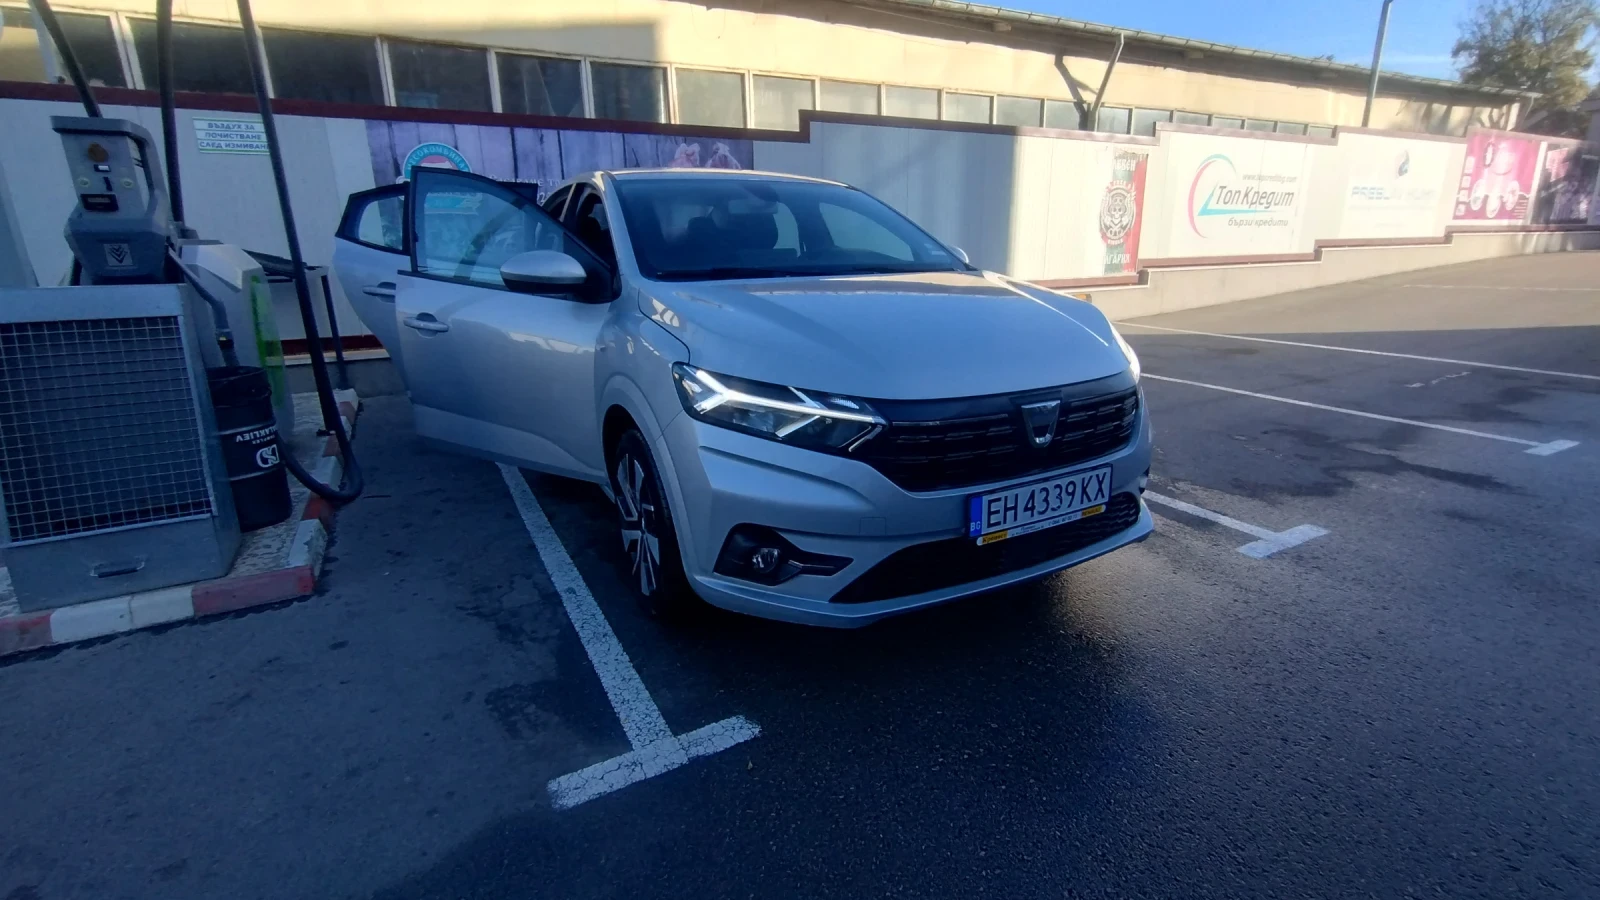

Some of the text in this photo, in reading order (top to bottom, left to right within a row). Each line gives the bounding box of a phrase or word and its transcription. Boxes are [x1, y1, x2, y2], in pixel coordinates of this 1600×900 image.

[207, 122, 256, 131] ВЪЗДУХ ЗА
[204, 131, 262, 140] ПОЧИСТВАНЕ
[199, 141, 223, 149] СЛЕД
[1241, 186, 1295, 209] Кредит
[1228, 217, 1289, 228] бързи кредити
[970, 521, 981, 532] BG
